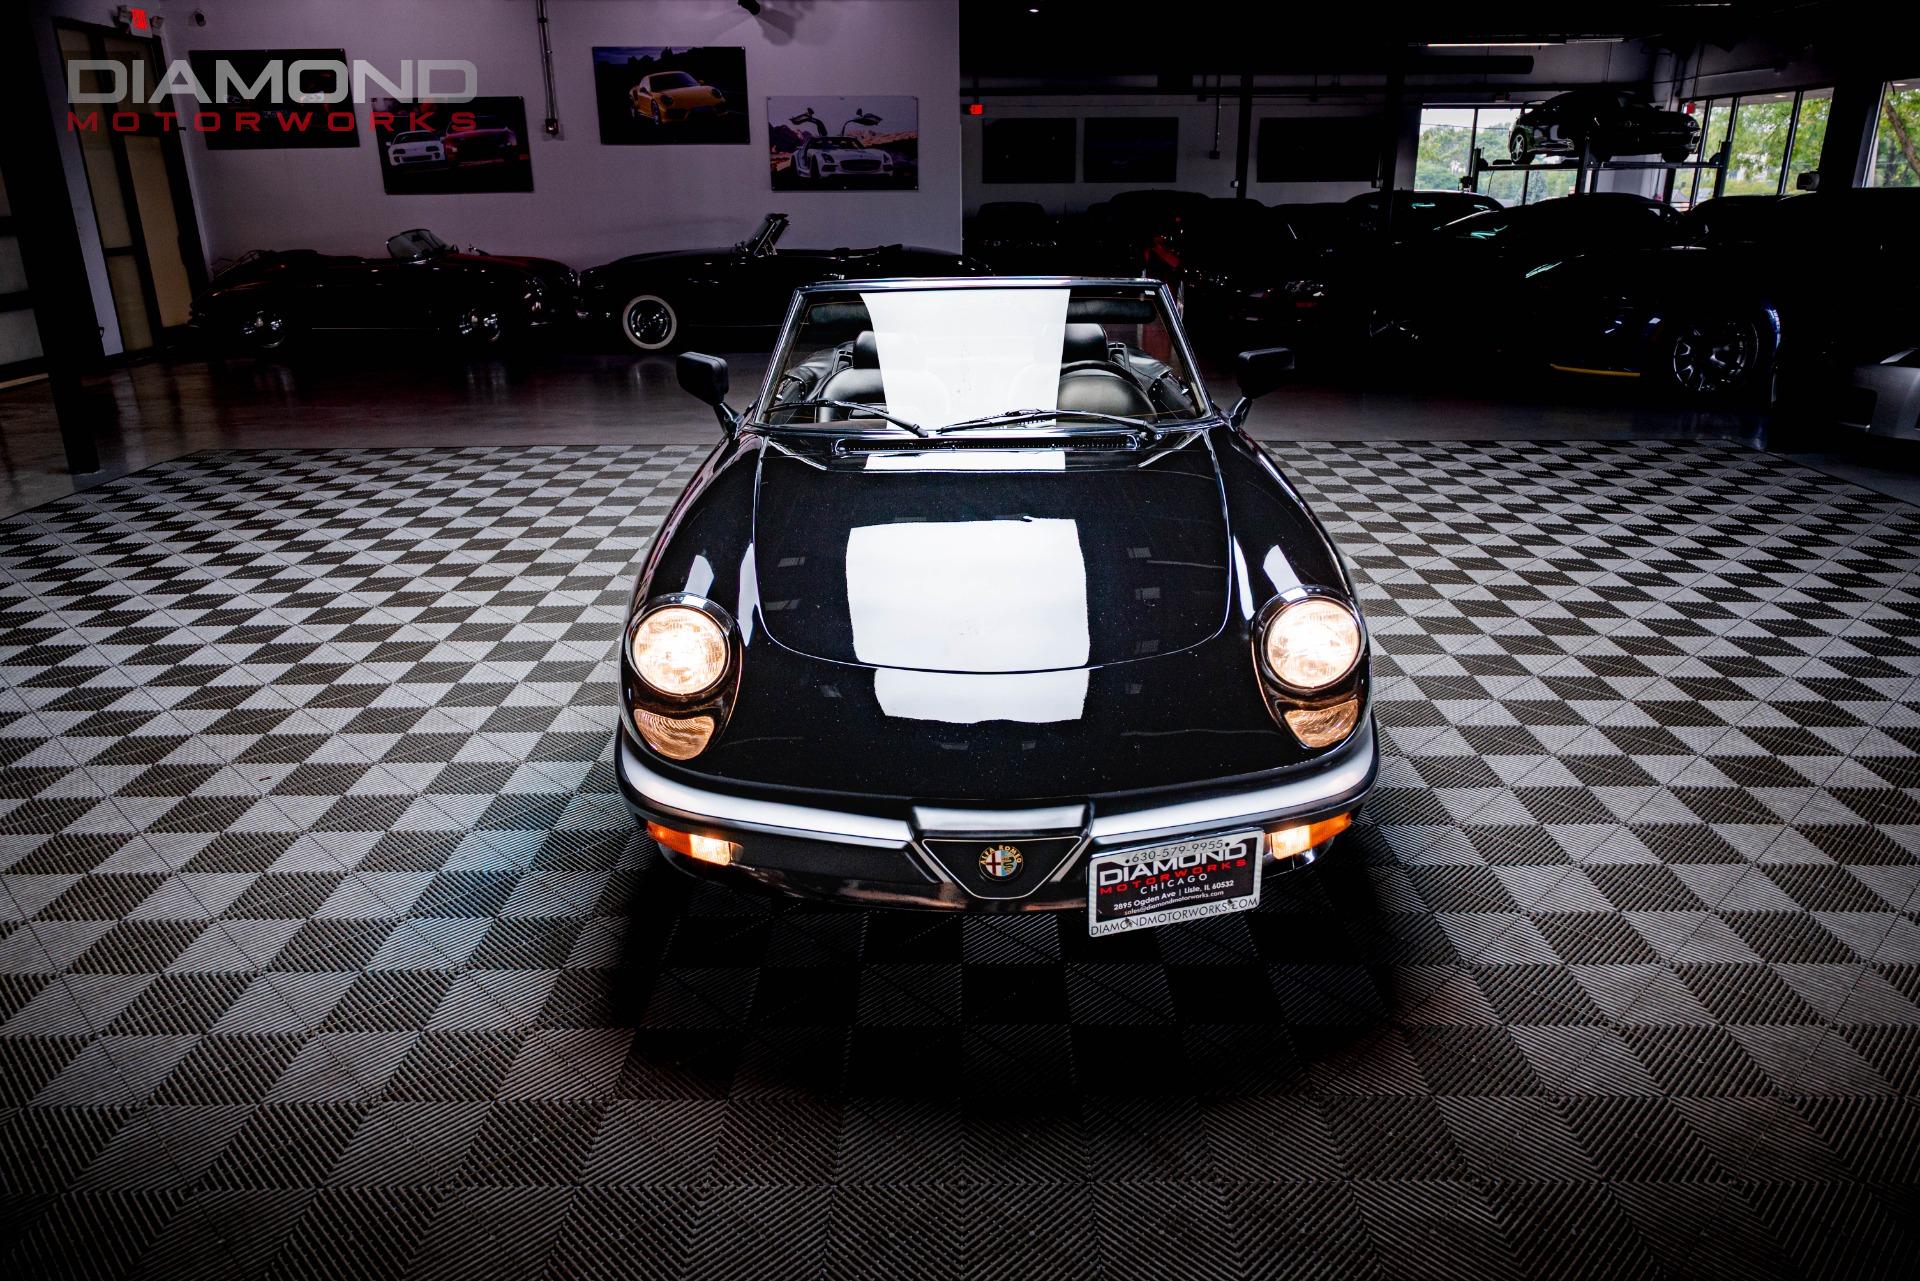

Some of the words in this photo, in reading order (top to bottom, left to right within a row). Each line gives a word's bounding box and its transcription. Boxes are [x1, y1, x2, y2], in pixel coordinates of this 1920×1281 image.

[999, 845, 1022, 863] ROMEO
[1100, 842, 1247, 886] DIAMOND
[1099, 859, 1247, 895] MOTORWORKS
[1140, 874, 1207, 894] CHICAGO
[1113, 902, 1132, 911] 2895
[1133, 893, 1160, 907] Ogden
[1161, 891, 1176, 899] Ave
[1212, 880, 1234, 889] 60532
[1124, 890, 1224, 915] sales@diamondmotorworks.com
